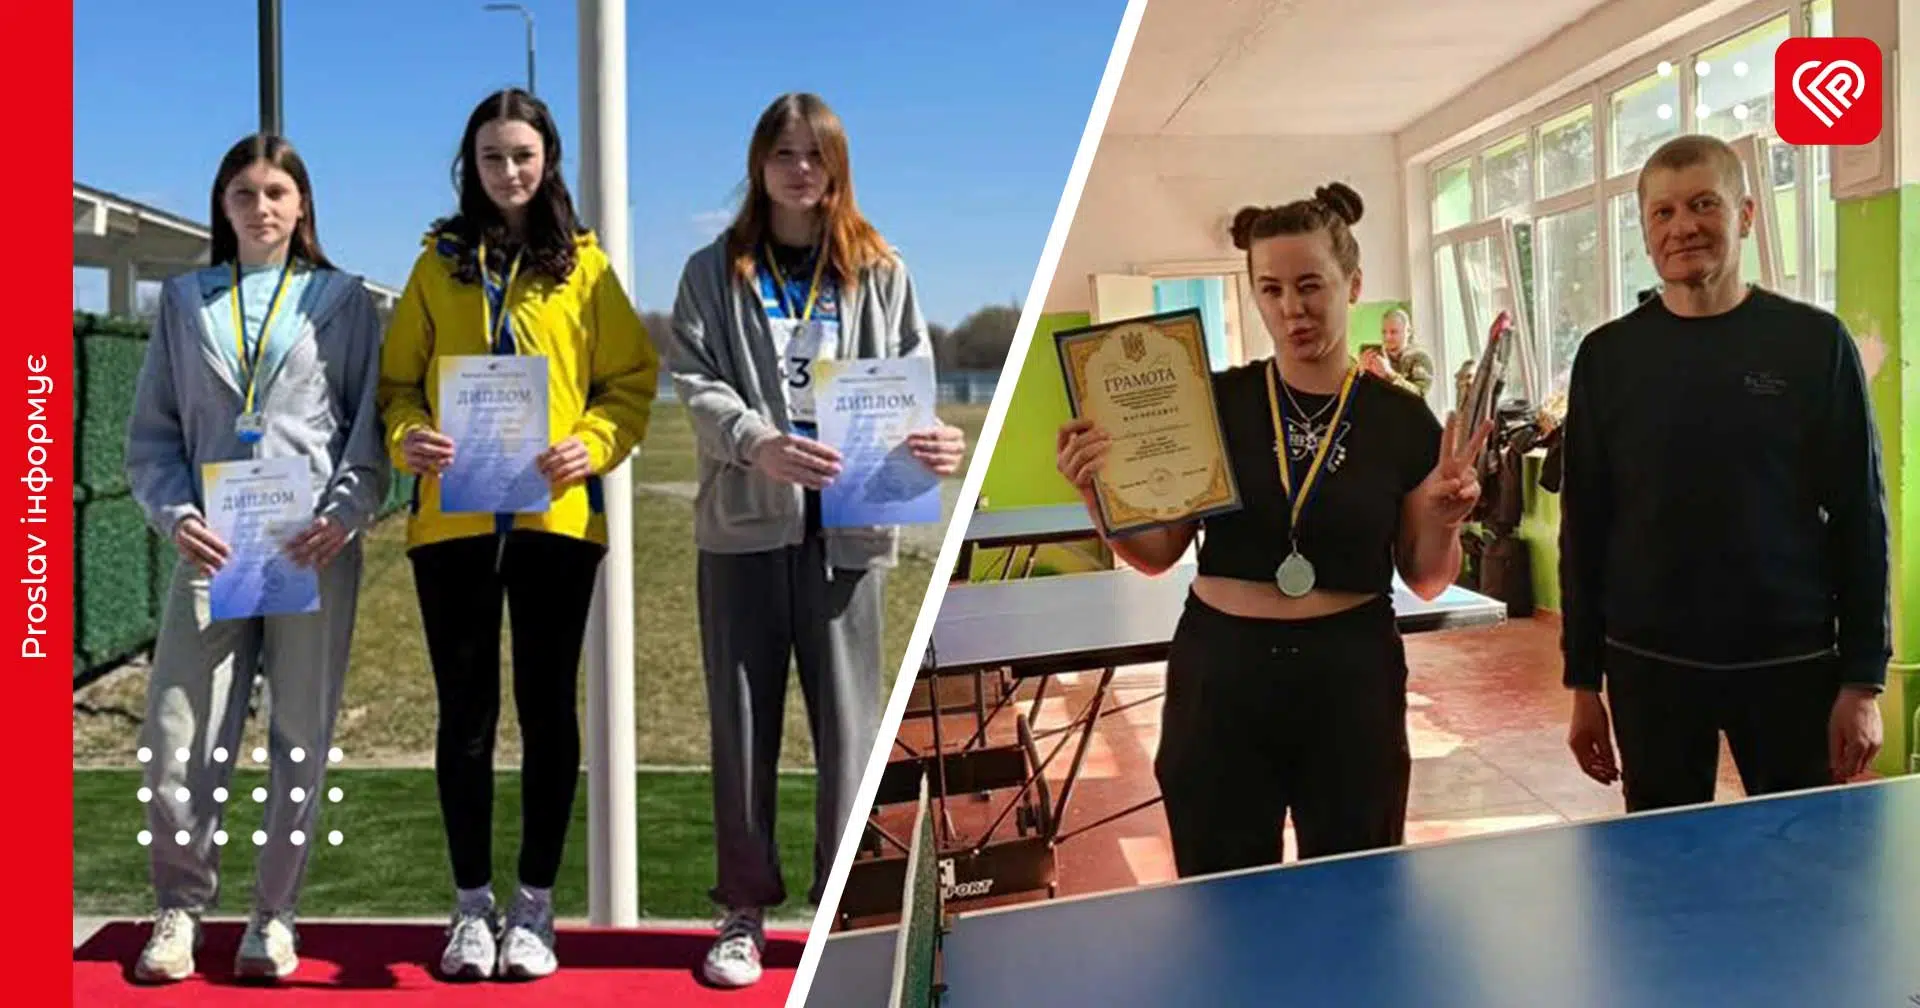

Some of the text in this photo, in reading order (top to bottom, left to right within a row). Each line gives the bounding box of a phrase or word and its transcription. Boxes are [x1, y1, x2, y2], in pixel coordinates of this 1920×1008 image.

[1103, 367, 1177, 393] ГРАМОТА
[456, 389, 533, 406] ДИПЛОМ
[834, 393, 917, 412] ДИПЛОМ
[221, 490, 295, 512] ДИПЛОМ
[942, 879, 994, 899] PORT
